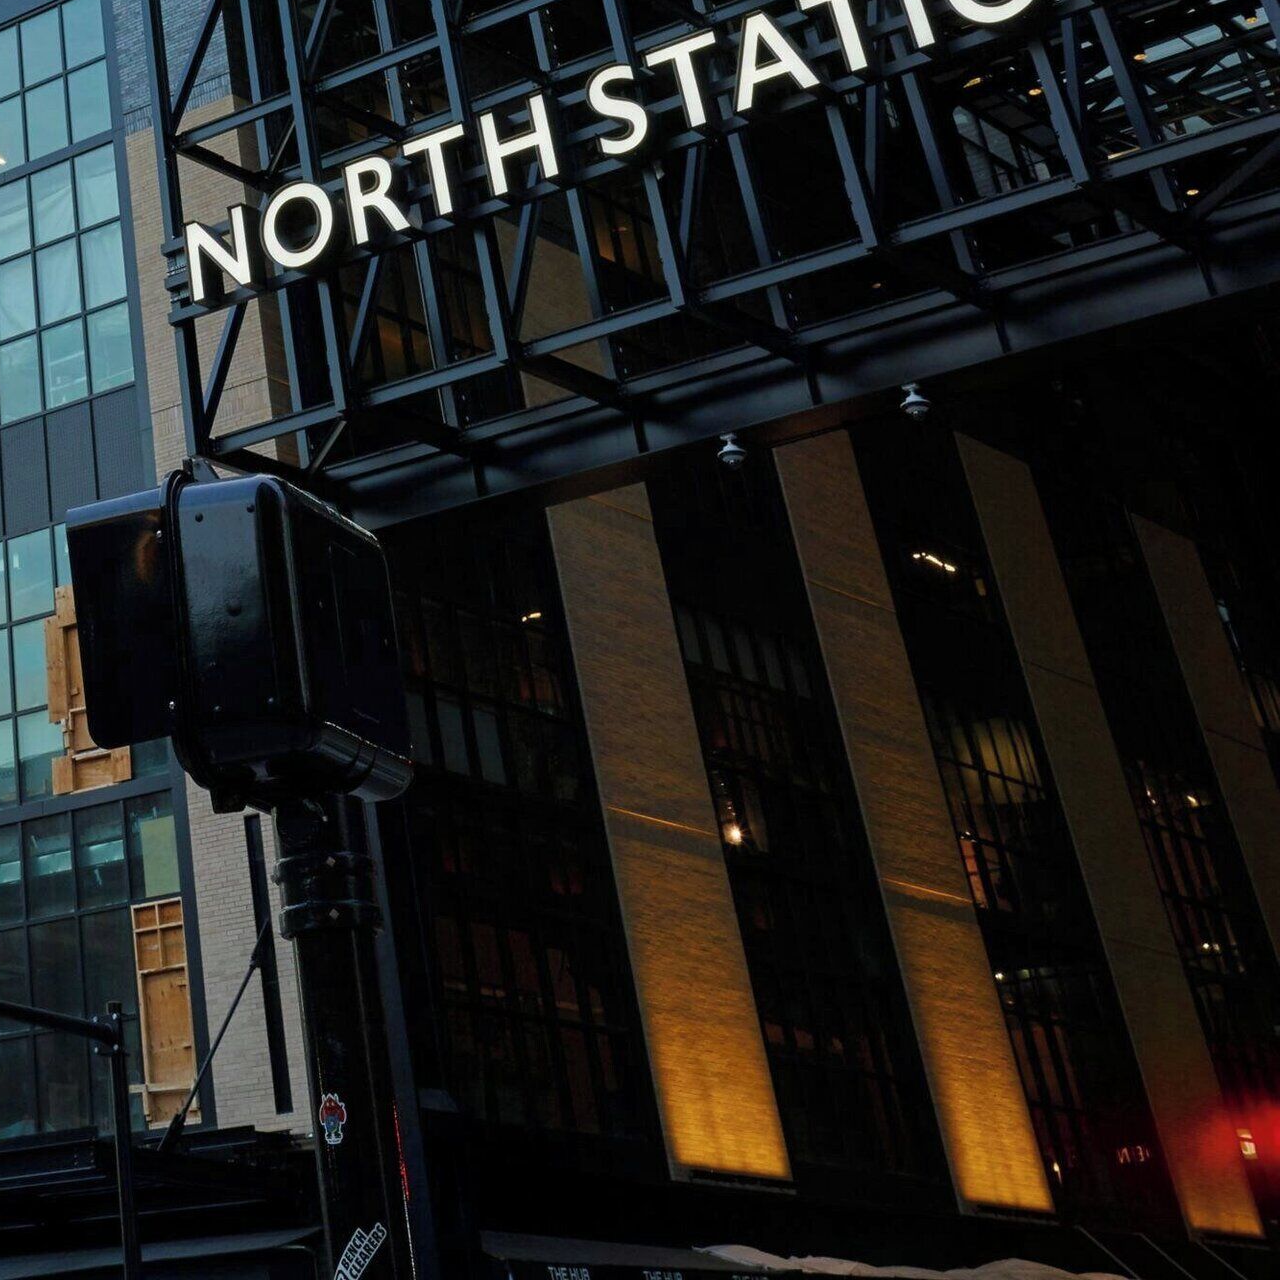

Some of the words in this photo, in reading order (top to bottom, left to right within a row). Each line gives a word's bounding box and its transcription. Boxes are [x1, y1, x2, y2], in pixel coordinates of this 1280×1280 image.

[183, 92, 560, 302] NORTH
[340, 1230, 368, 1270] BENCH
[349, 1224, 386, 1280] CLEARERS
[547, 1266, 568, 1280] THE
